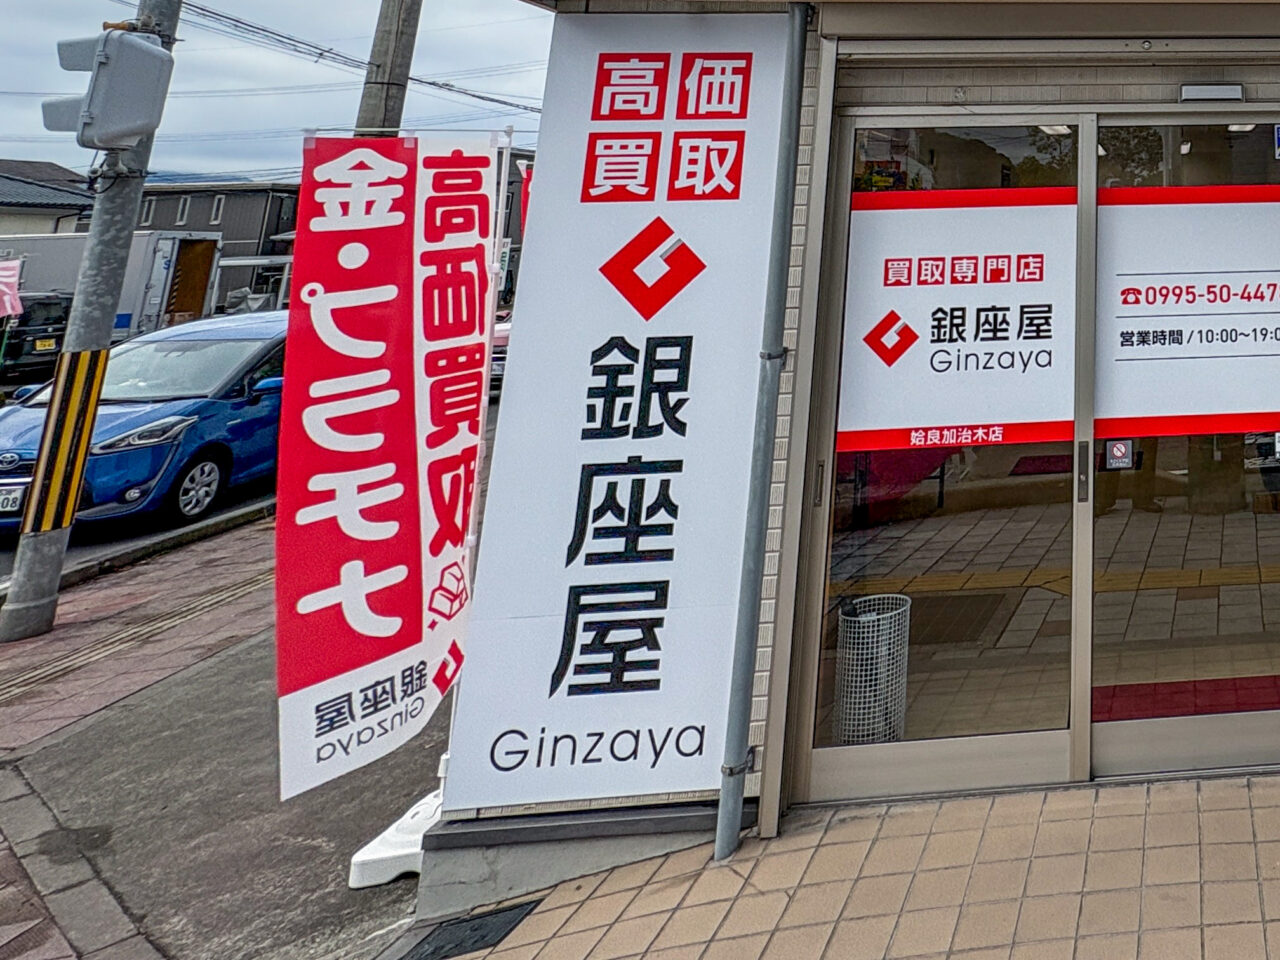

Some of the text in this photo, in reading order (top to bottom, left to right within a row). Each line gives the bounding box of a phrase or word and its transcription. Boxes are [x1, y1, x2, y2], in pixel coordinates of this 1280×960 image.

[602, 57, 748, 116] 高価
[588, 134, 739, 198] 買取
[885, 255, 1043, 285] 買取専門店
[929, 303, 1054, 344] 銀座屋
[929, 346, 1053, 375] Ginzaya
[910, 426, 1005, 448] 姶良加治木店
[548, 335, 695, 700] 銀座屋
[489, 721, 707, 775] Ginzaya
